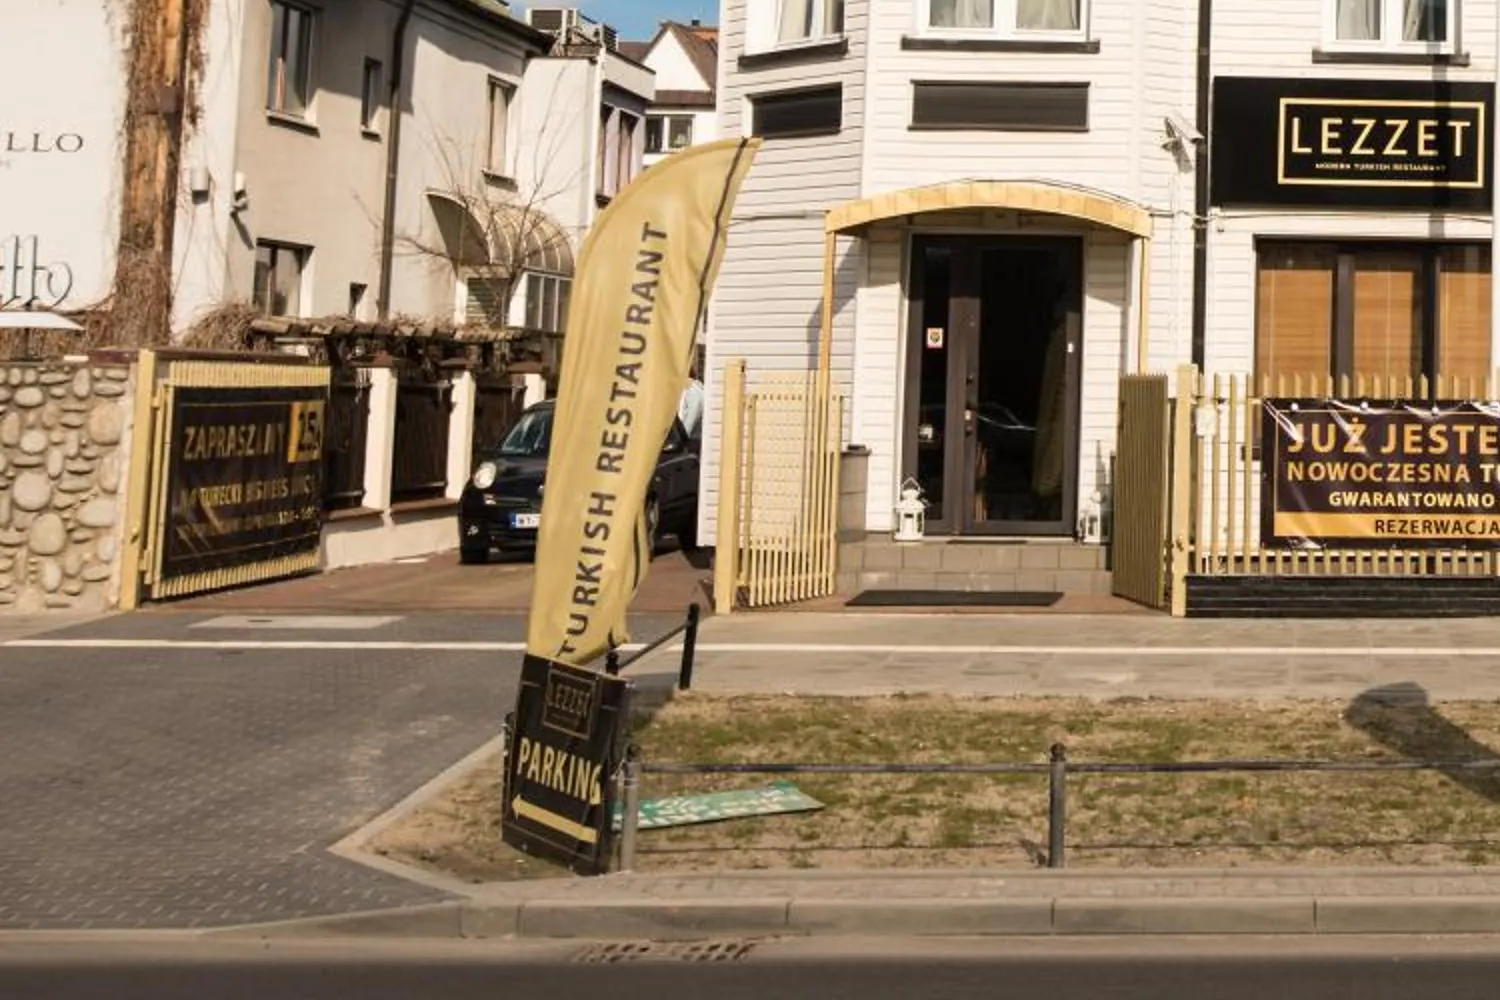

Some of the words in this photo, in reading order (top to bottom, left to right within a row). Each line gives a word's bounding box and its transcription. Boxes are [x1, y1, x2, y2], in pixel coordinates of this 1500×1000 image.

[1292, 117, 1471, 157] LEZZET
[558, 491, 616, 657] TURKISH
[595, 221, 668, 473] RESTAURANT
[1287, 416, 1367, 454] JUŻ
[1287, 461, 1471, 484] NOWOCZESNA
[1329, 491, 1495, 508] GWARANTOWANO
[517, 737, 603, 806] PARKING
